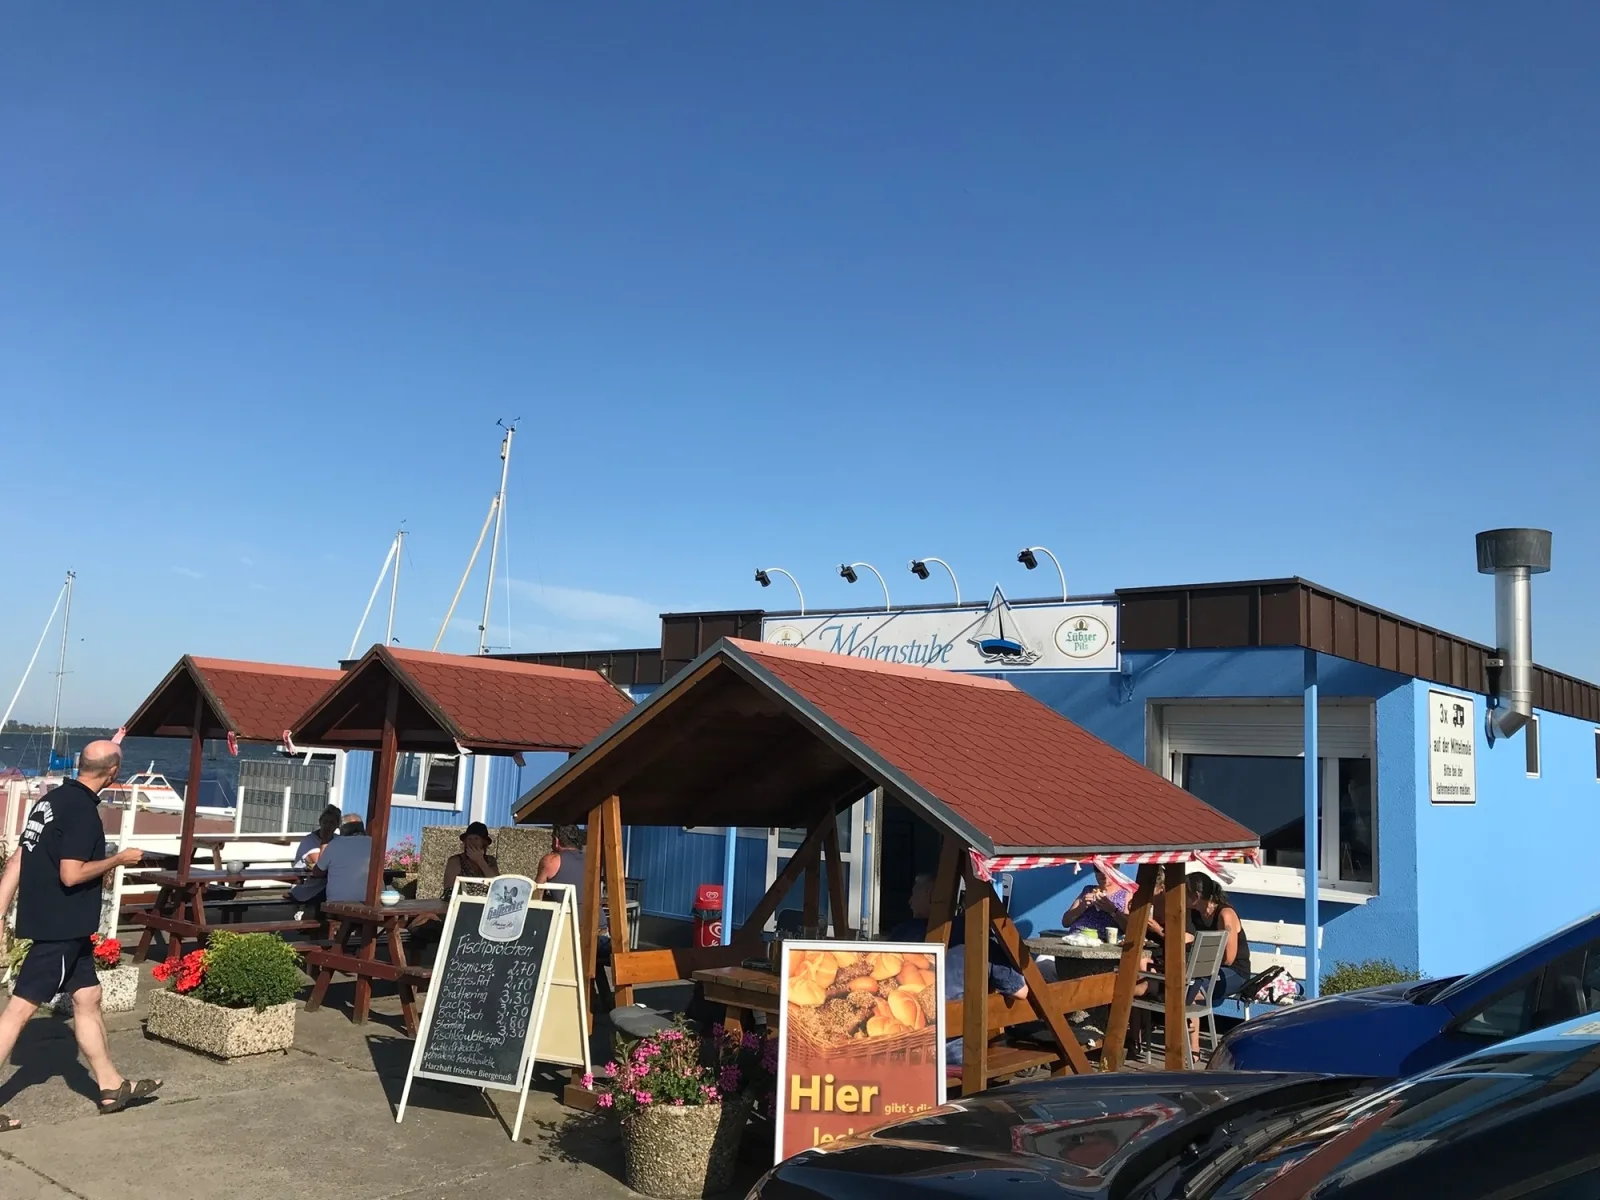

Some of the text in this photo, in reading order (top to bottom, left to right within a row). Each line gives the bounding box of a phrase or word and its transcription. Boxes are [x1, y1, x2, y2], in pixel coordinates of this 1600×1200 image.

[819, 622, 954, 665] Molenstube
[1065, 631, 1097, 643] Lübzer
[1074, 642, 1089, 651] Pils
[1440, 703, 1448, 724] 3x
[1433, 737, 1471, 756] auf der Mittelmole
[441, 986, 488, 1003] Brathering
[439, 999, 472, 1010] Lachs
[438, 1008, 484, 1023] Backfisch
[424, 1062, 512, 1081] Harzhaft frischer Biergenuß
[790, 1073, 879, 1113] Hier
